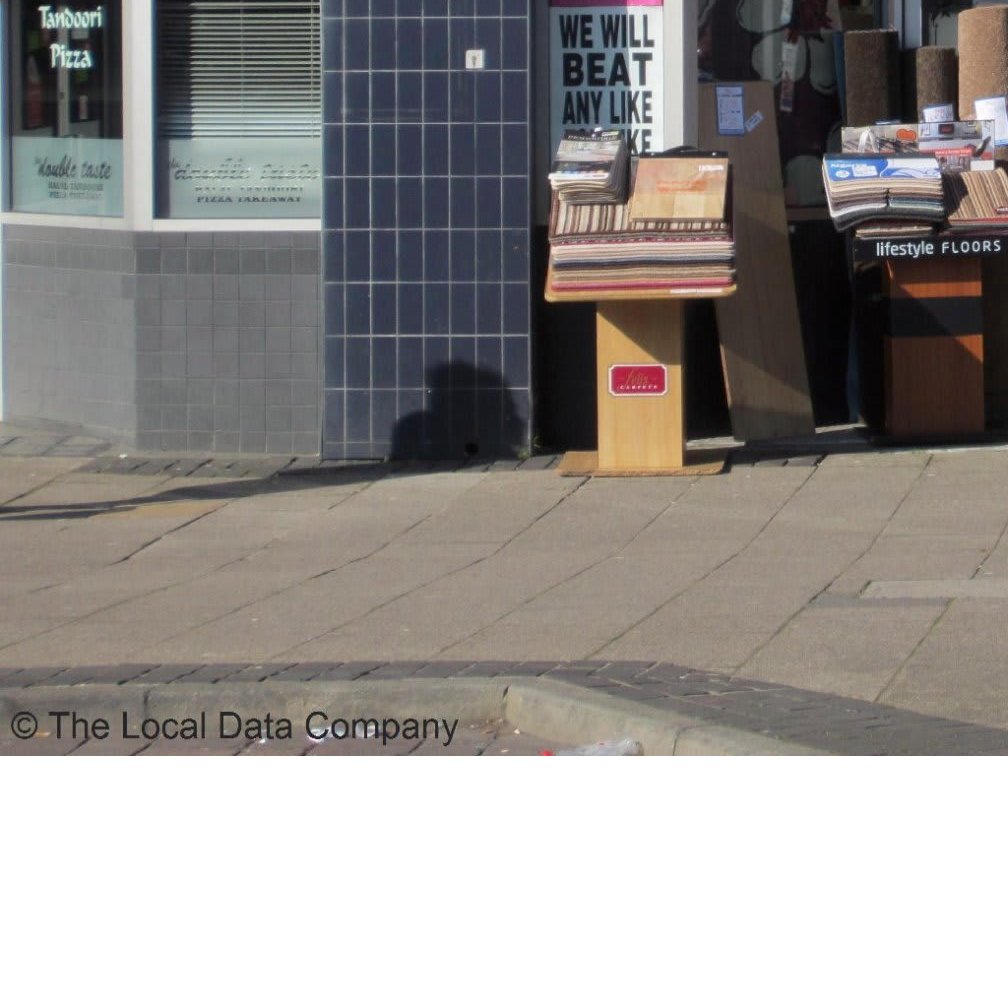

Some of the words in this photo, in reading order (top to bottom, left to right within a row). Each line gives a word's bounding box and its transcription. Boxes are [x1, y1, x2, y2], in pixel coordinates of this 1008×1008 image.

[38, 5, 103, 29] Tandoori
[559, 14, 593, 48] WE
[600, 14, 655, 48] WILL
[50, 43, 93, 69] Pizza
[562, 53, 654, 87] BEAT
[562, 91, 603, 124] ANY
[609, 91, 653, 124] LIKE
[876, 241, 934, 258] lifestyle
[941, 240, 1001, 254] FLOORS
